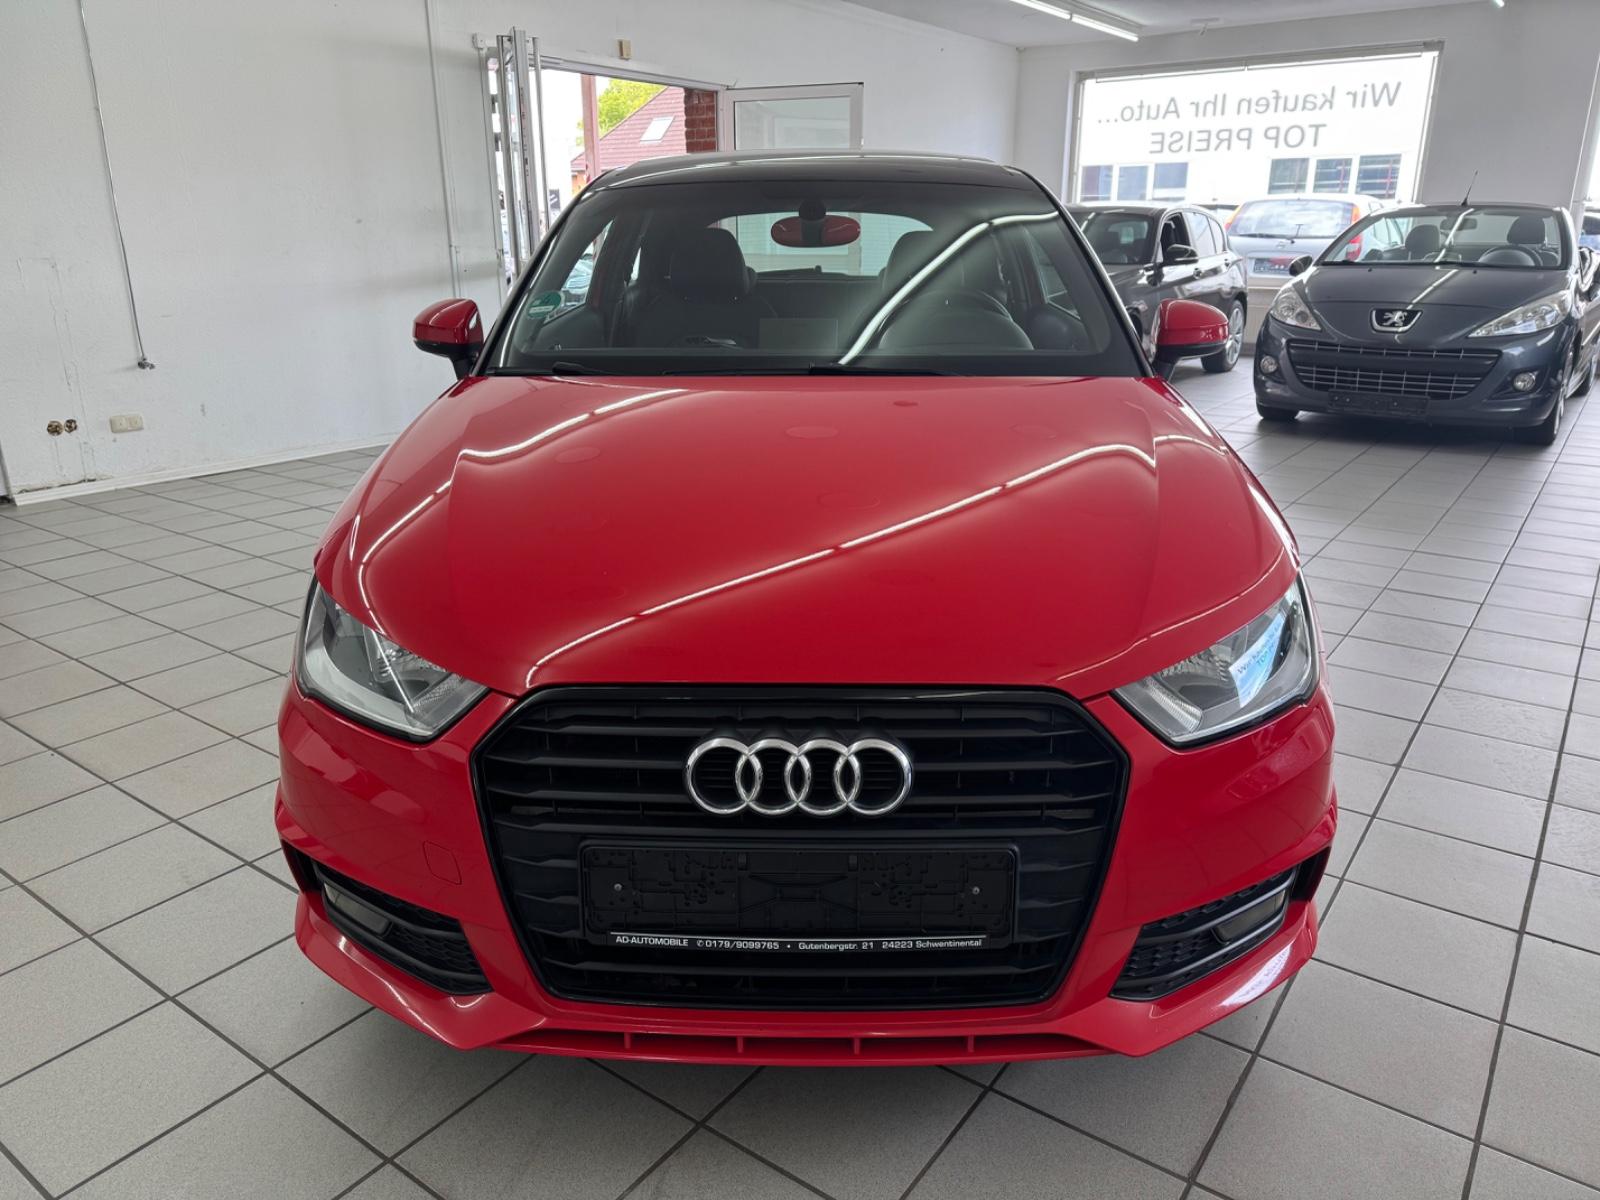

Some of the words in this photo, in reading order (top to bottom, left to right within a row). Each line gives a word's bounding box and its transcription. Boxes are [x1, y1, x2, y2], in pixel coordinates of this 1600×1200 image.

[615, 936, 689, 947] AD-AUTOMOBILE
[798, 942, 858, 951] Gutenbergstr.
[862, 942, 874, 950] 21
[882, 941, 913, 949] 24223
[915, 939, 982, 949] Schwentinental
